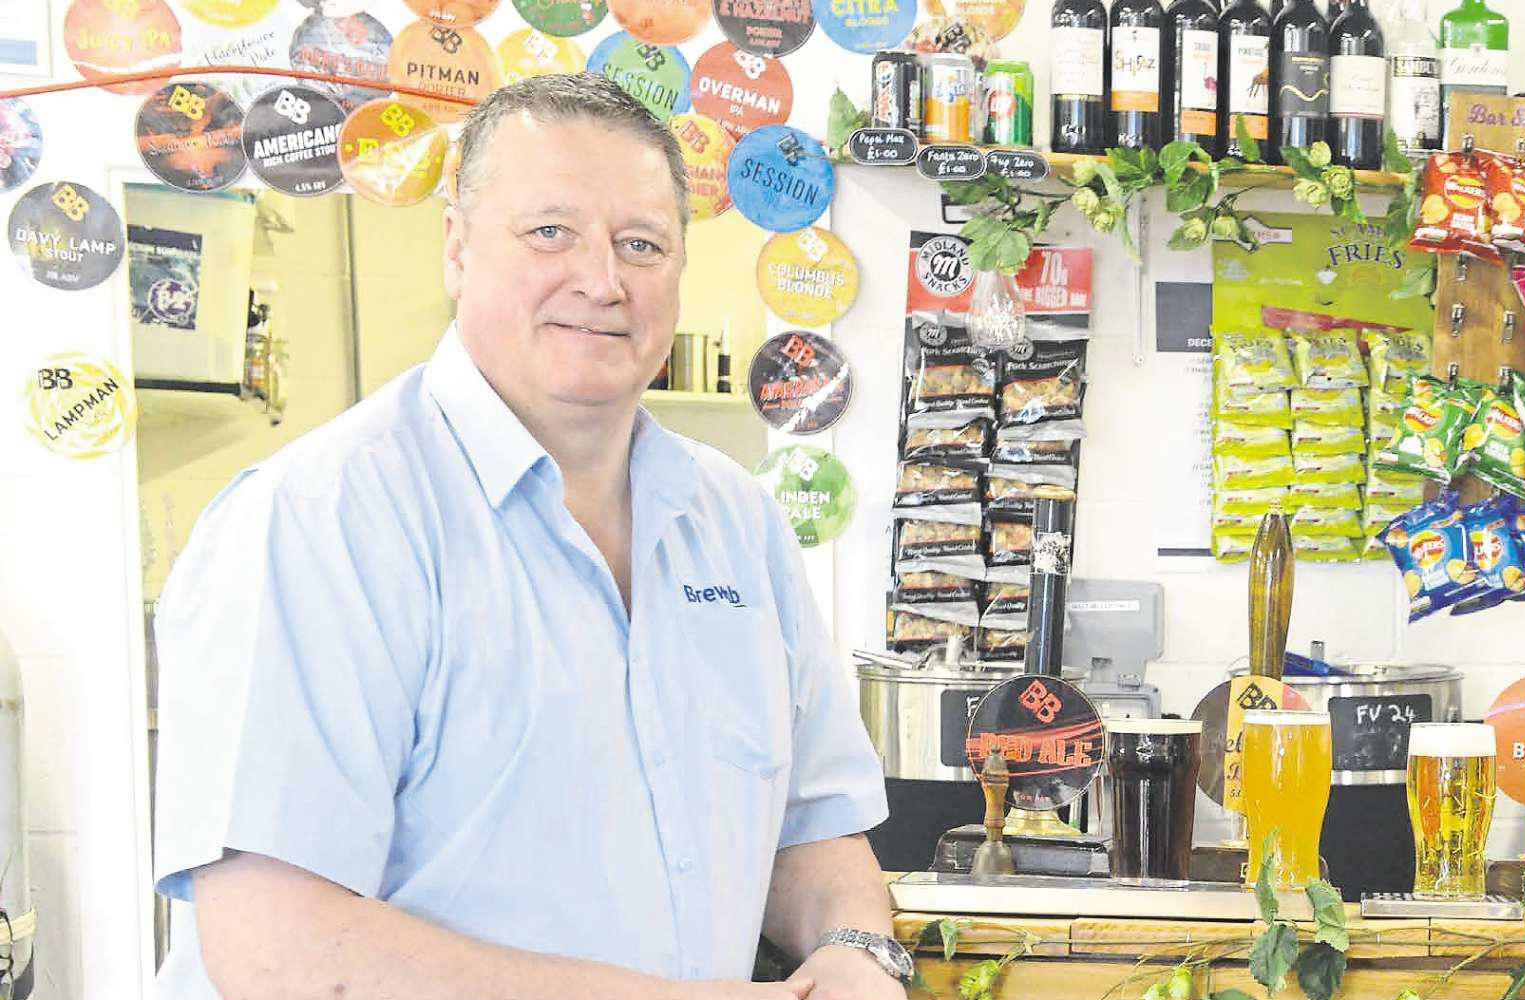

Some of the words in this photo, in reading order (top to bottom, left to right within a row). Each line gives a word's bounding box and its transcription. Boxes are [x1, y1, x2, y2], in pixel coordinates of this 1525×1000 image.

[75, 28, 133, 50] JUICY
[407, 62, 479, 84] PITMAN
[602, 63, 678, 111] SESSION
[698, 77, 780, 114] OVERMAN
[1467, 103, 1506, 125] Bar
[315, 143, 337, 158] STOU
[741, 158, 819, 206] SESSION
[16, 227, 61, 246] DAVY
[70, 237, 117, 257] LAMP
[45, 249, 84, 262] STOUT
[1328, 243, 1403, 269] FRIES
[768, 262, 846, 287] COLUMBUS
[922, 271, 969, 293] SNACKS
[777, 279, 833, 299] BLONDE
[38, 368, 73, 391] BB
[44, 378, 119, 441] LAMPMAN
[783, 507, 821, 520] PALE
[1356, 706, 1382, 724] FV
[1391, 704, 1415, 722] 24
[1038, 739, 1093, 767] ALE
